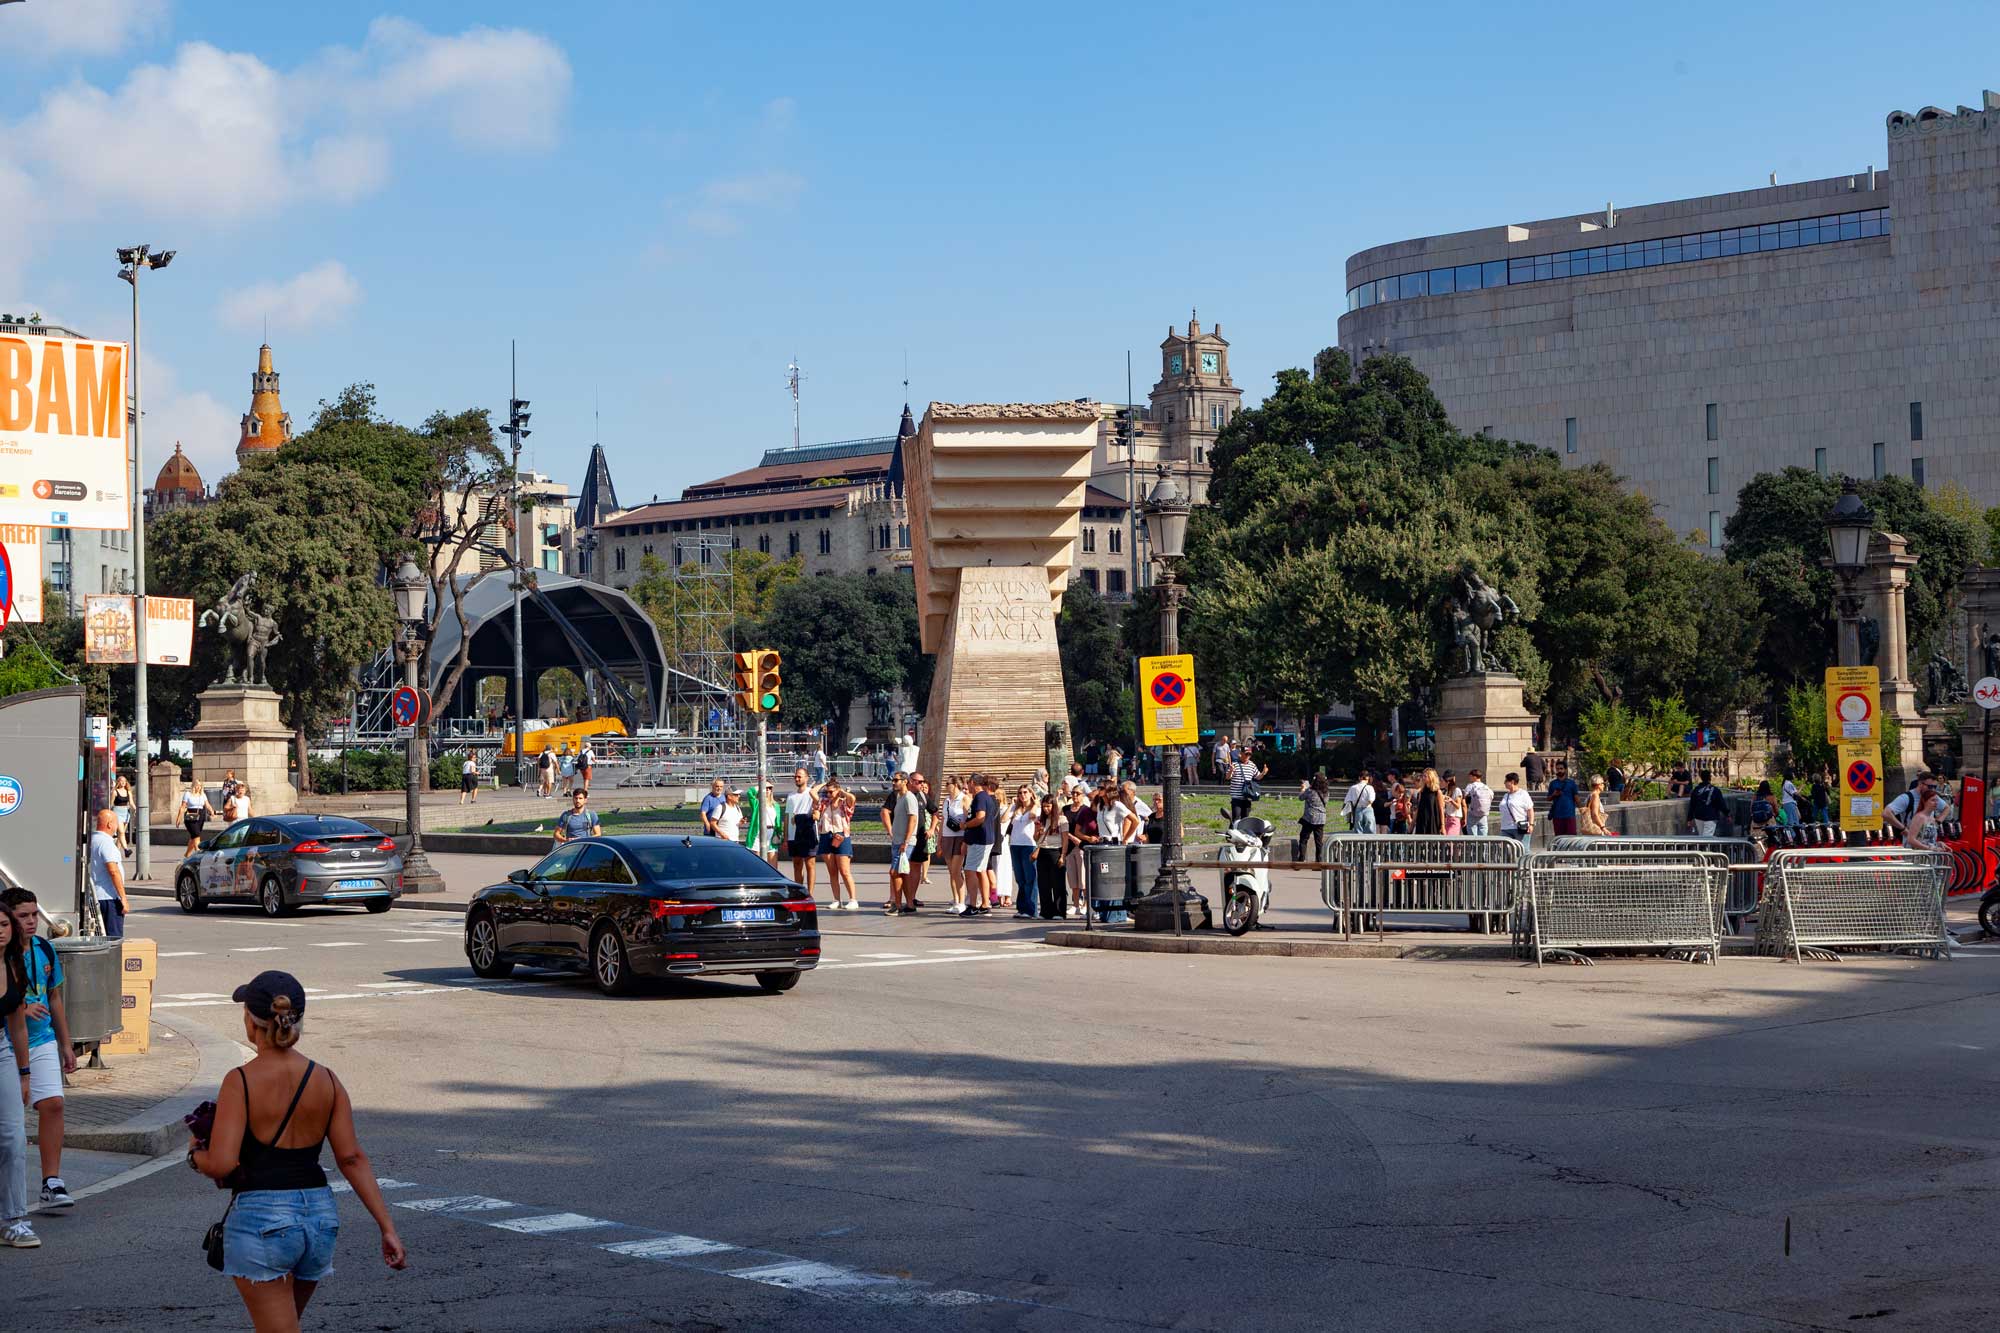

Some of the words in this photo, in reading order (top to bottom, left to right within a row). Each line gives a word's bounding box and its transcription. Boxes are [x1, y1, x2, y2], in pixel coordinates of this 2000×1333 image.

[0, 337, 121, 438] BAM
[961, 582, 1048, 594] CATALUNYA
[1000, 593, 1010, 606] A
[961, 606, 1052, 622] FRANCESC
